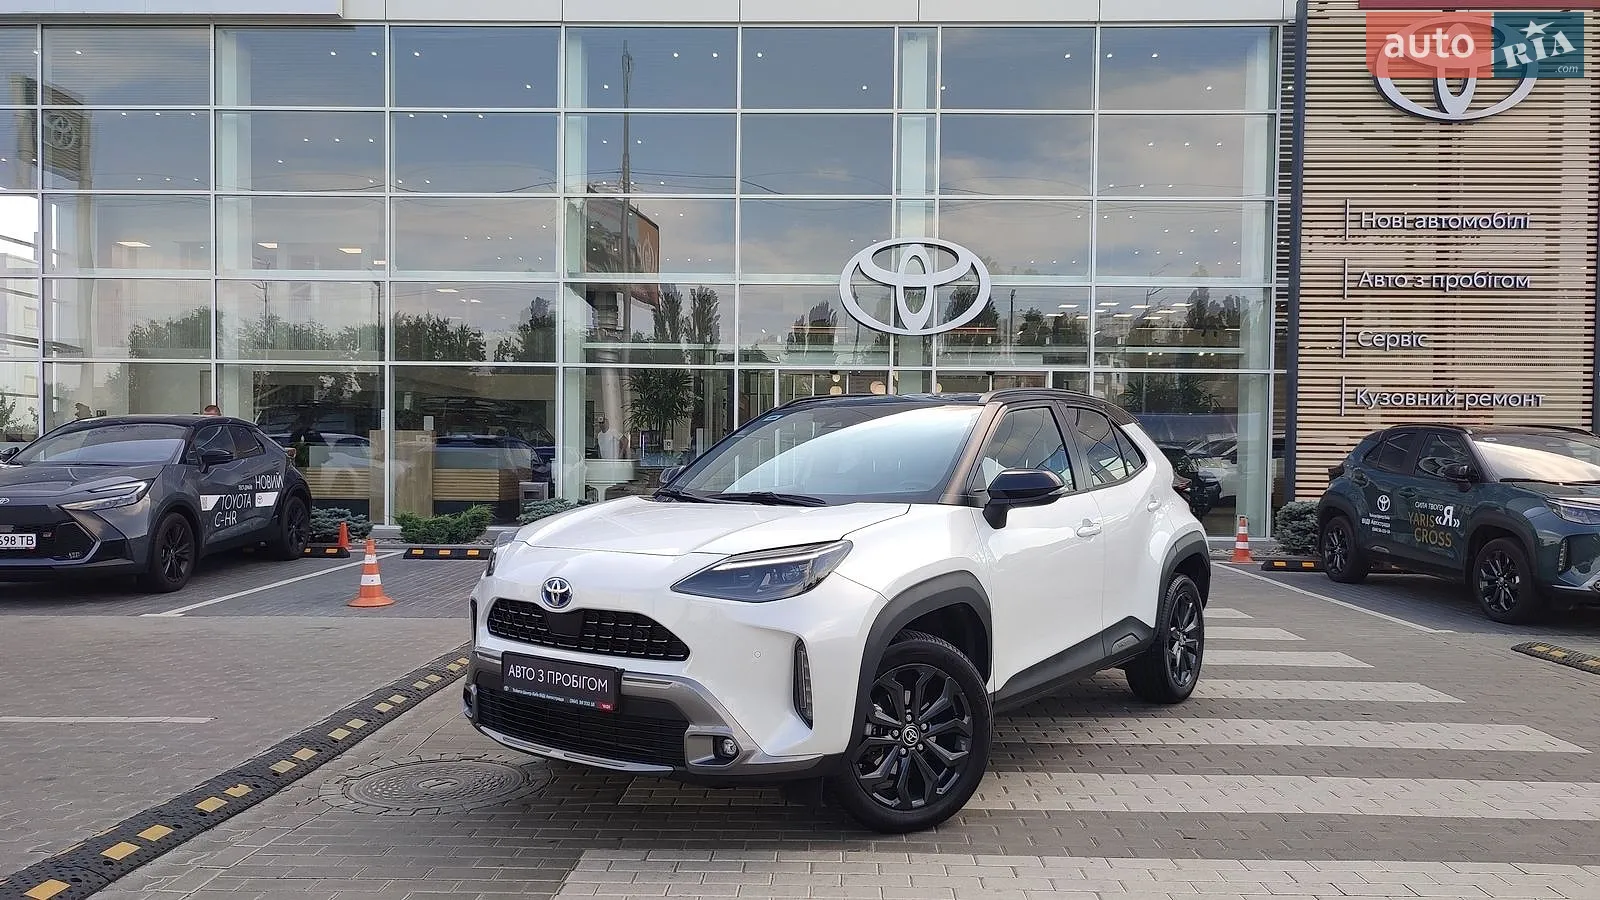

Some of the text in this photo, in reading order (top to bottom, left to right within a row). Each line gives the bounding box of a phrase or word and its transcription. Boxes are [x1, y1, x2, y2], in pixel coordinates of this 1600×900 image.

[1360, 211, 1532, 230] Нові автомобілі
[1357, 271, 1532, 293] Авто з пробігом
[1356, 330, 1430, 351] Сервіс
[1355, 387, 1547, 411] Кузовний ремонт
[254, 472, 284, 490] НОВИЙ
[221, 494, 252, 511] TOYOTA
[215, 510, 237, 527] C-HR
[1408, 511, 1435, 528] YARIS
[1414, 528, 1452, 547] CROSS
[508, 664, 536, 681] АВТО
[547, 670, 609, 693] ПРОБІГОМ
